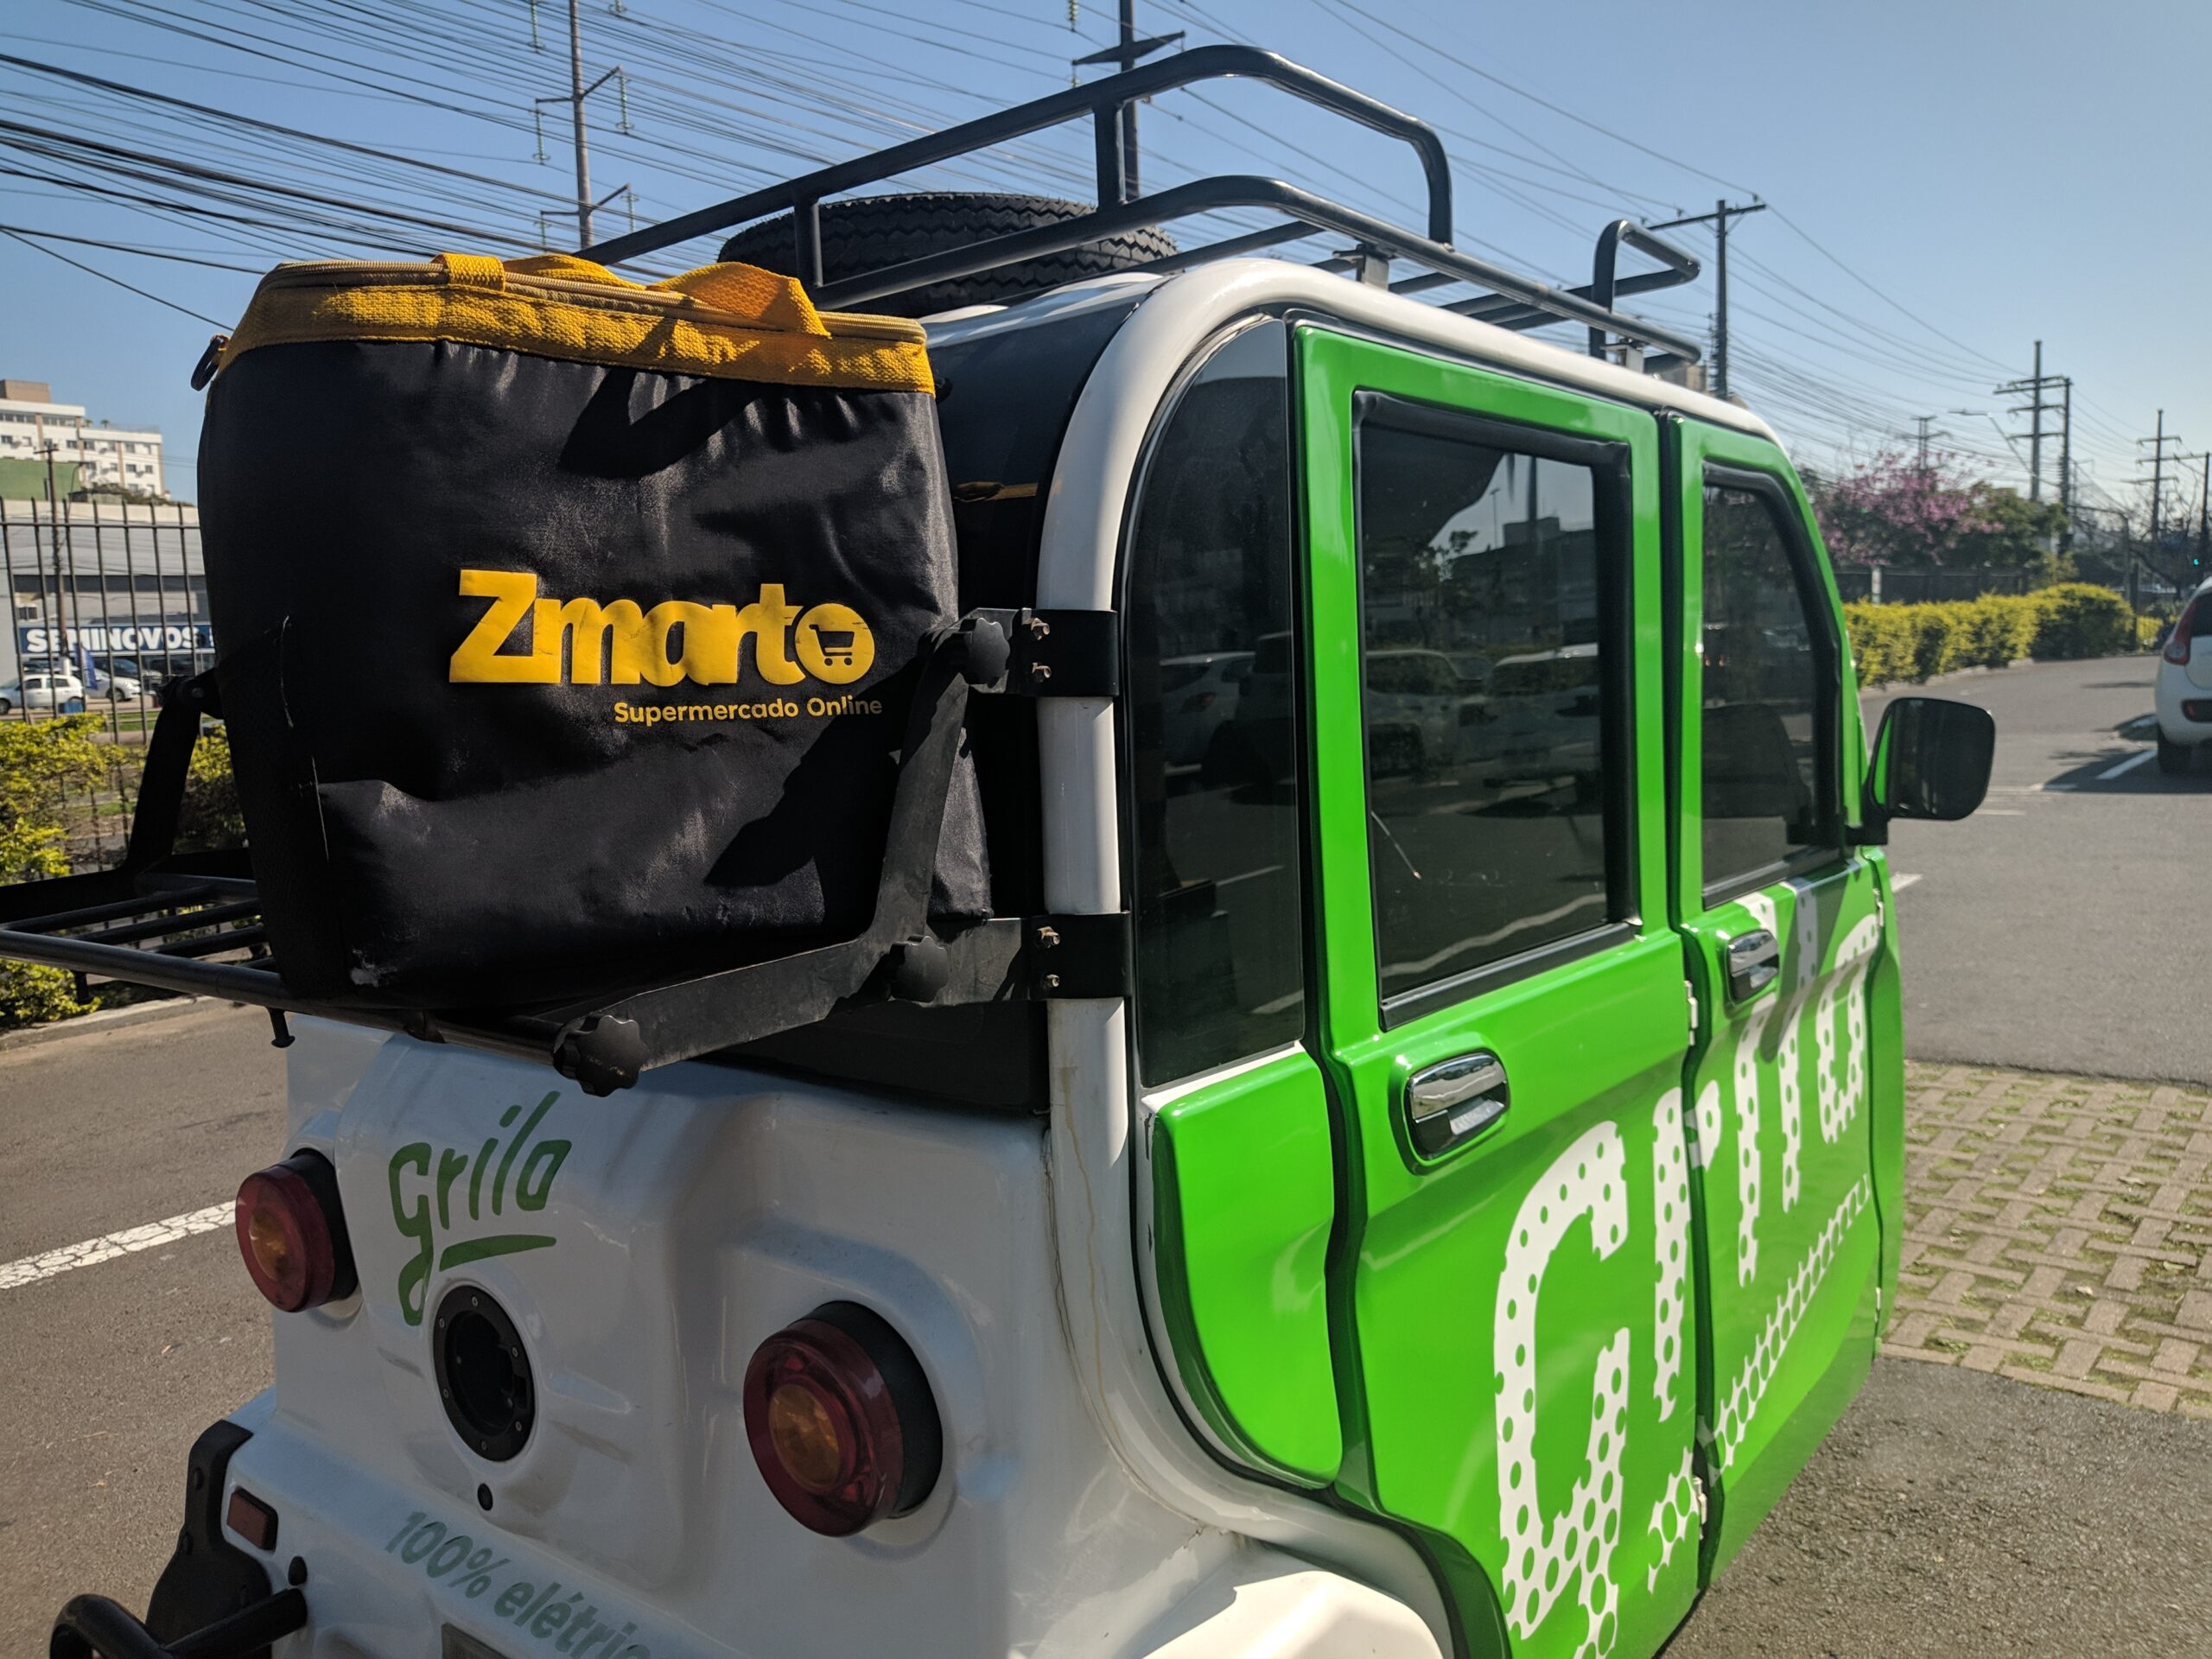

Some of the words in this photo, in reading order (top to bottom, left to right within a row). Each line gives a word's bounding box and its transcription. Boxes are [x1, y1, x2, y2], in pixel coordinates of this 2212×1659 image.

[26, 626, 199, 652] SEMINOVOS
[613, 698, 799, 727] Supermercado
[806, 694, 883, 717] Online
[385, 1512, 512, 1599] 100%
